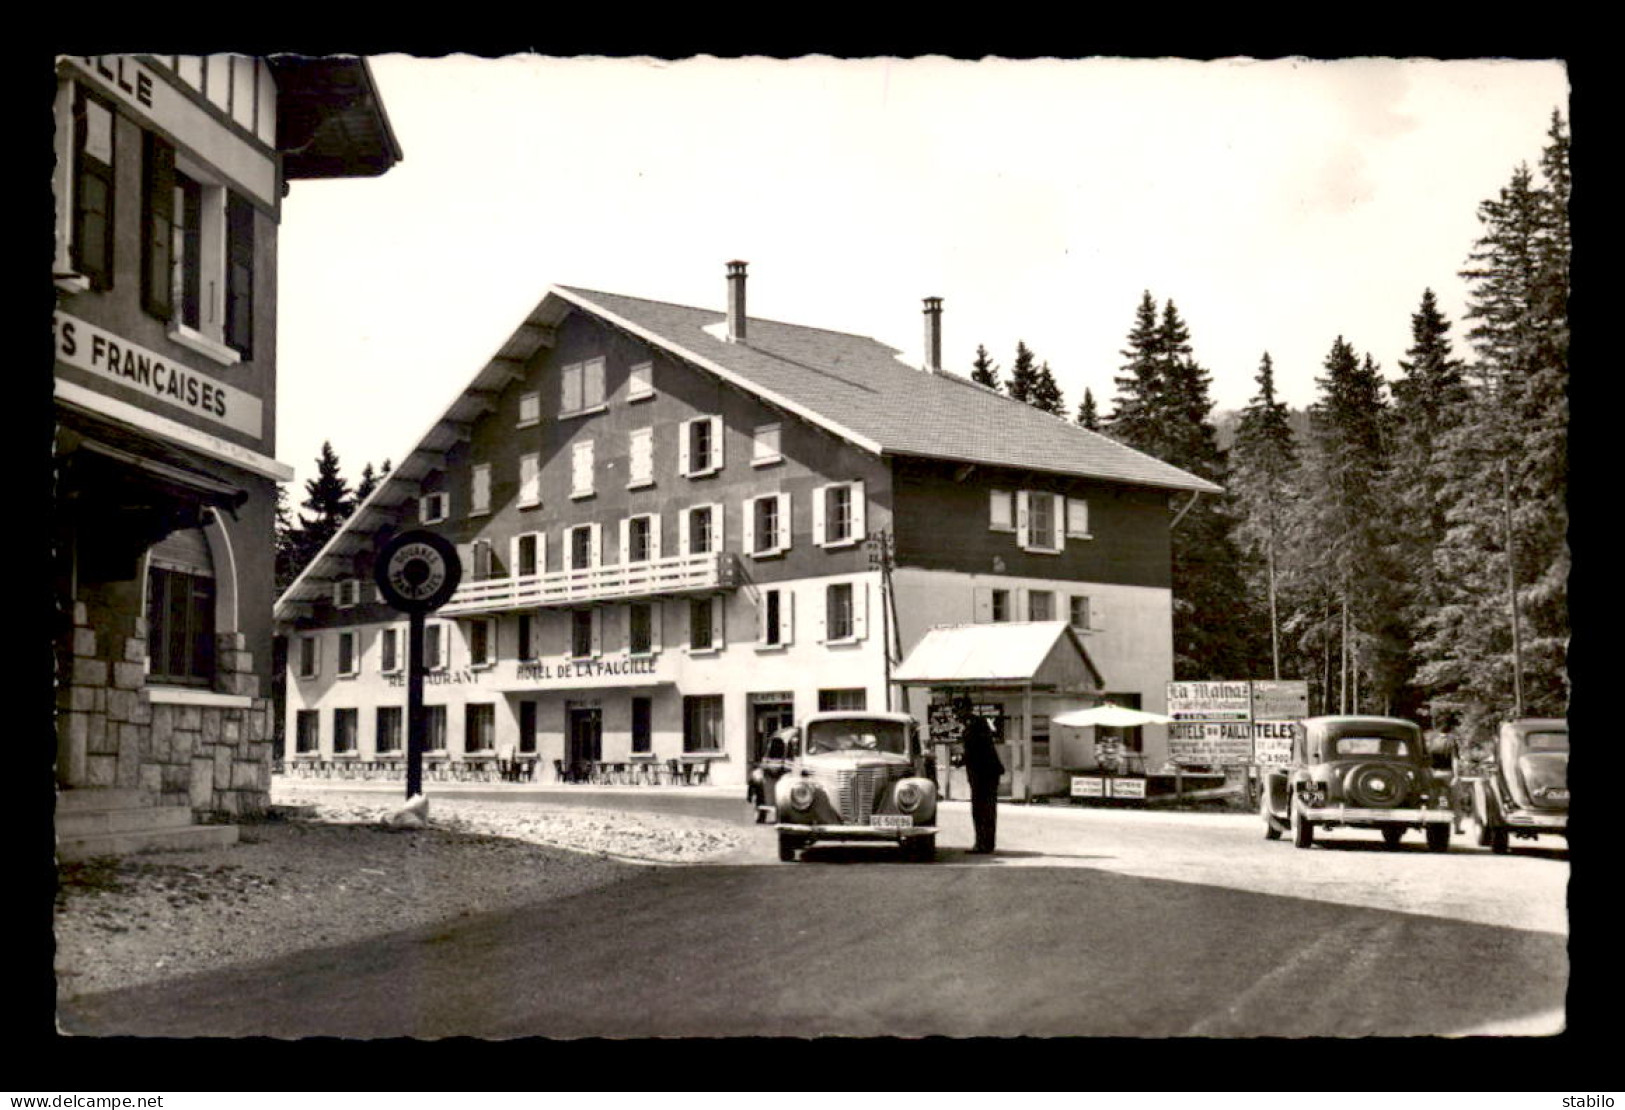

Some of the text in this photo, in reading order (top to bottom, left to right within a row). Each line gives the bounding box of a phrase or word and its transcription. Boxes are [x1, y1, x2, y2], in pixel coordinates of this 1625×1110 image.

[85, 56, 153, 109] LLE
[92, 334, 226, 418] FRANÇAISES
[389, 670, 480, 687] REAURANT
[557, 664, 573, 678] DE
[577, 663, 593, 678] LA
[597, 658, 656, 677] FAUCILLE
